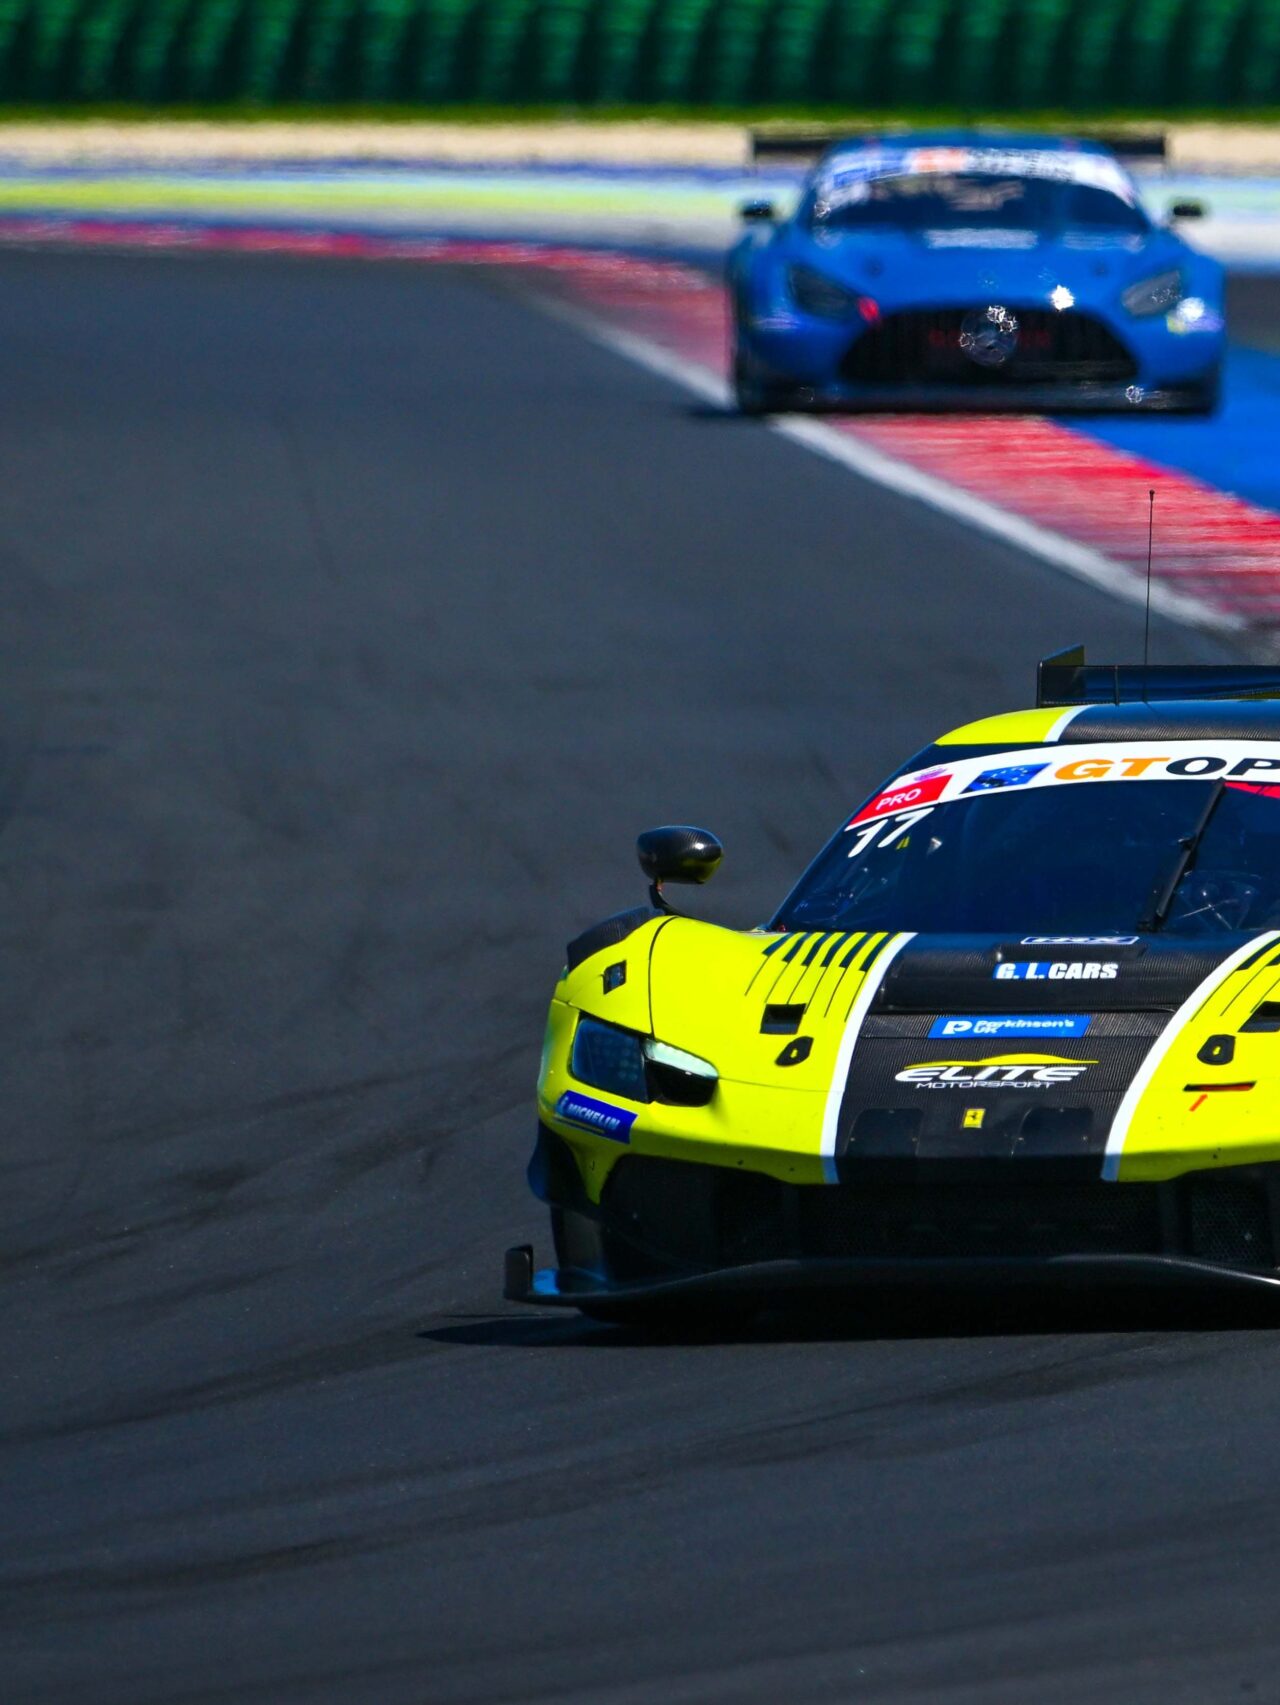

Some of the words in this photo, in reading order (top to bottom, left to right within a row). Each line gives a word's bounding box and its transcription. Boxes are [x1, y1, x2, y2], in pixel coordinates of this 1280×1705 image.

[875, 787, 923, 811] PRO
[847, 806, 936, 859] 17
[975, 1019, 1075, 1029] Parkinson's
[894, 1066, 1088, 1082] ELITE
[915, 1080, 1056, 1090] MOTORSPORT
[567, 1101, 622, 1132] MICHELIN
